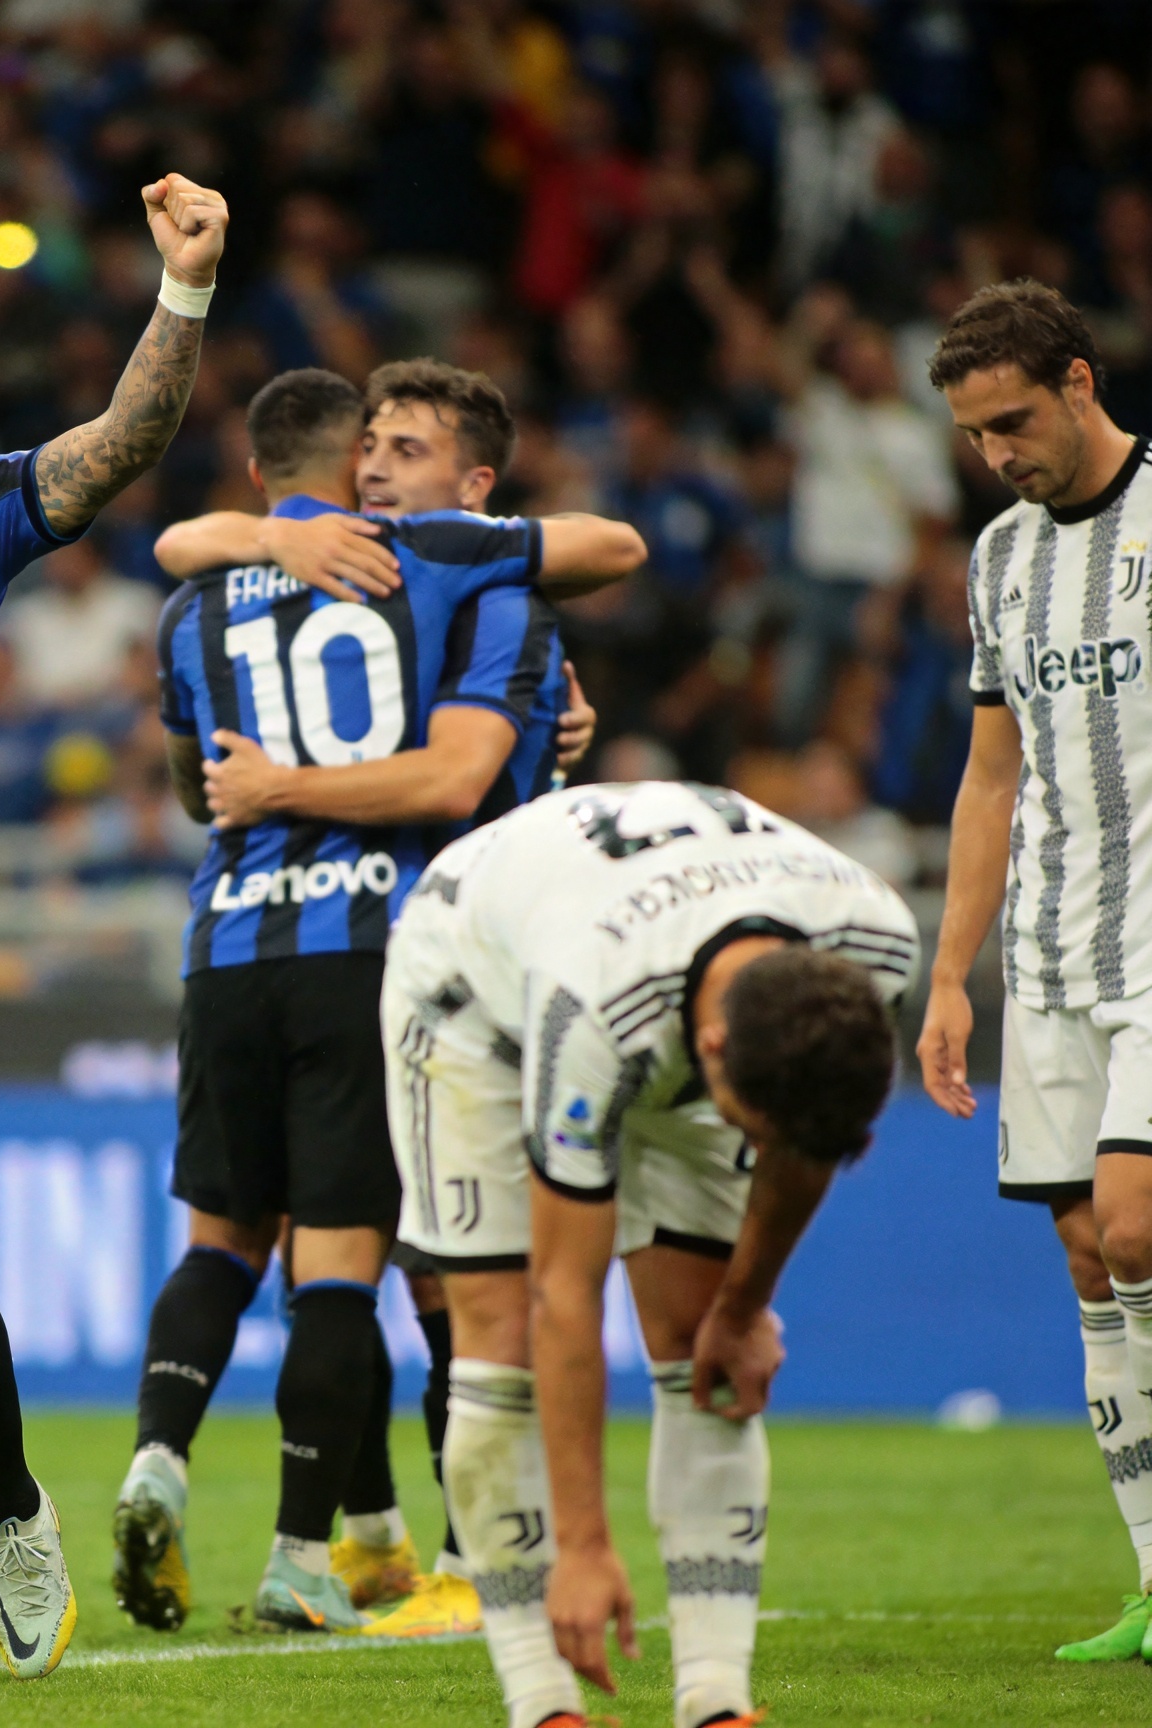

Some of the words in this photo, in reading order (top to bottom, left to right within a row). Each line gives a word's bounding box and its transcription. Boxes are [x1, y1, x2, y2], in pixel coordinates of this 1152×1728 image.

[225, 602, 407, 768] 10
[1012, 635, 1143, 701] Jeep
[210, 851, 398, 911] Lenovo
